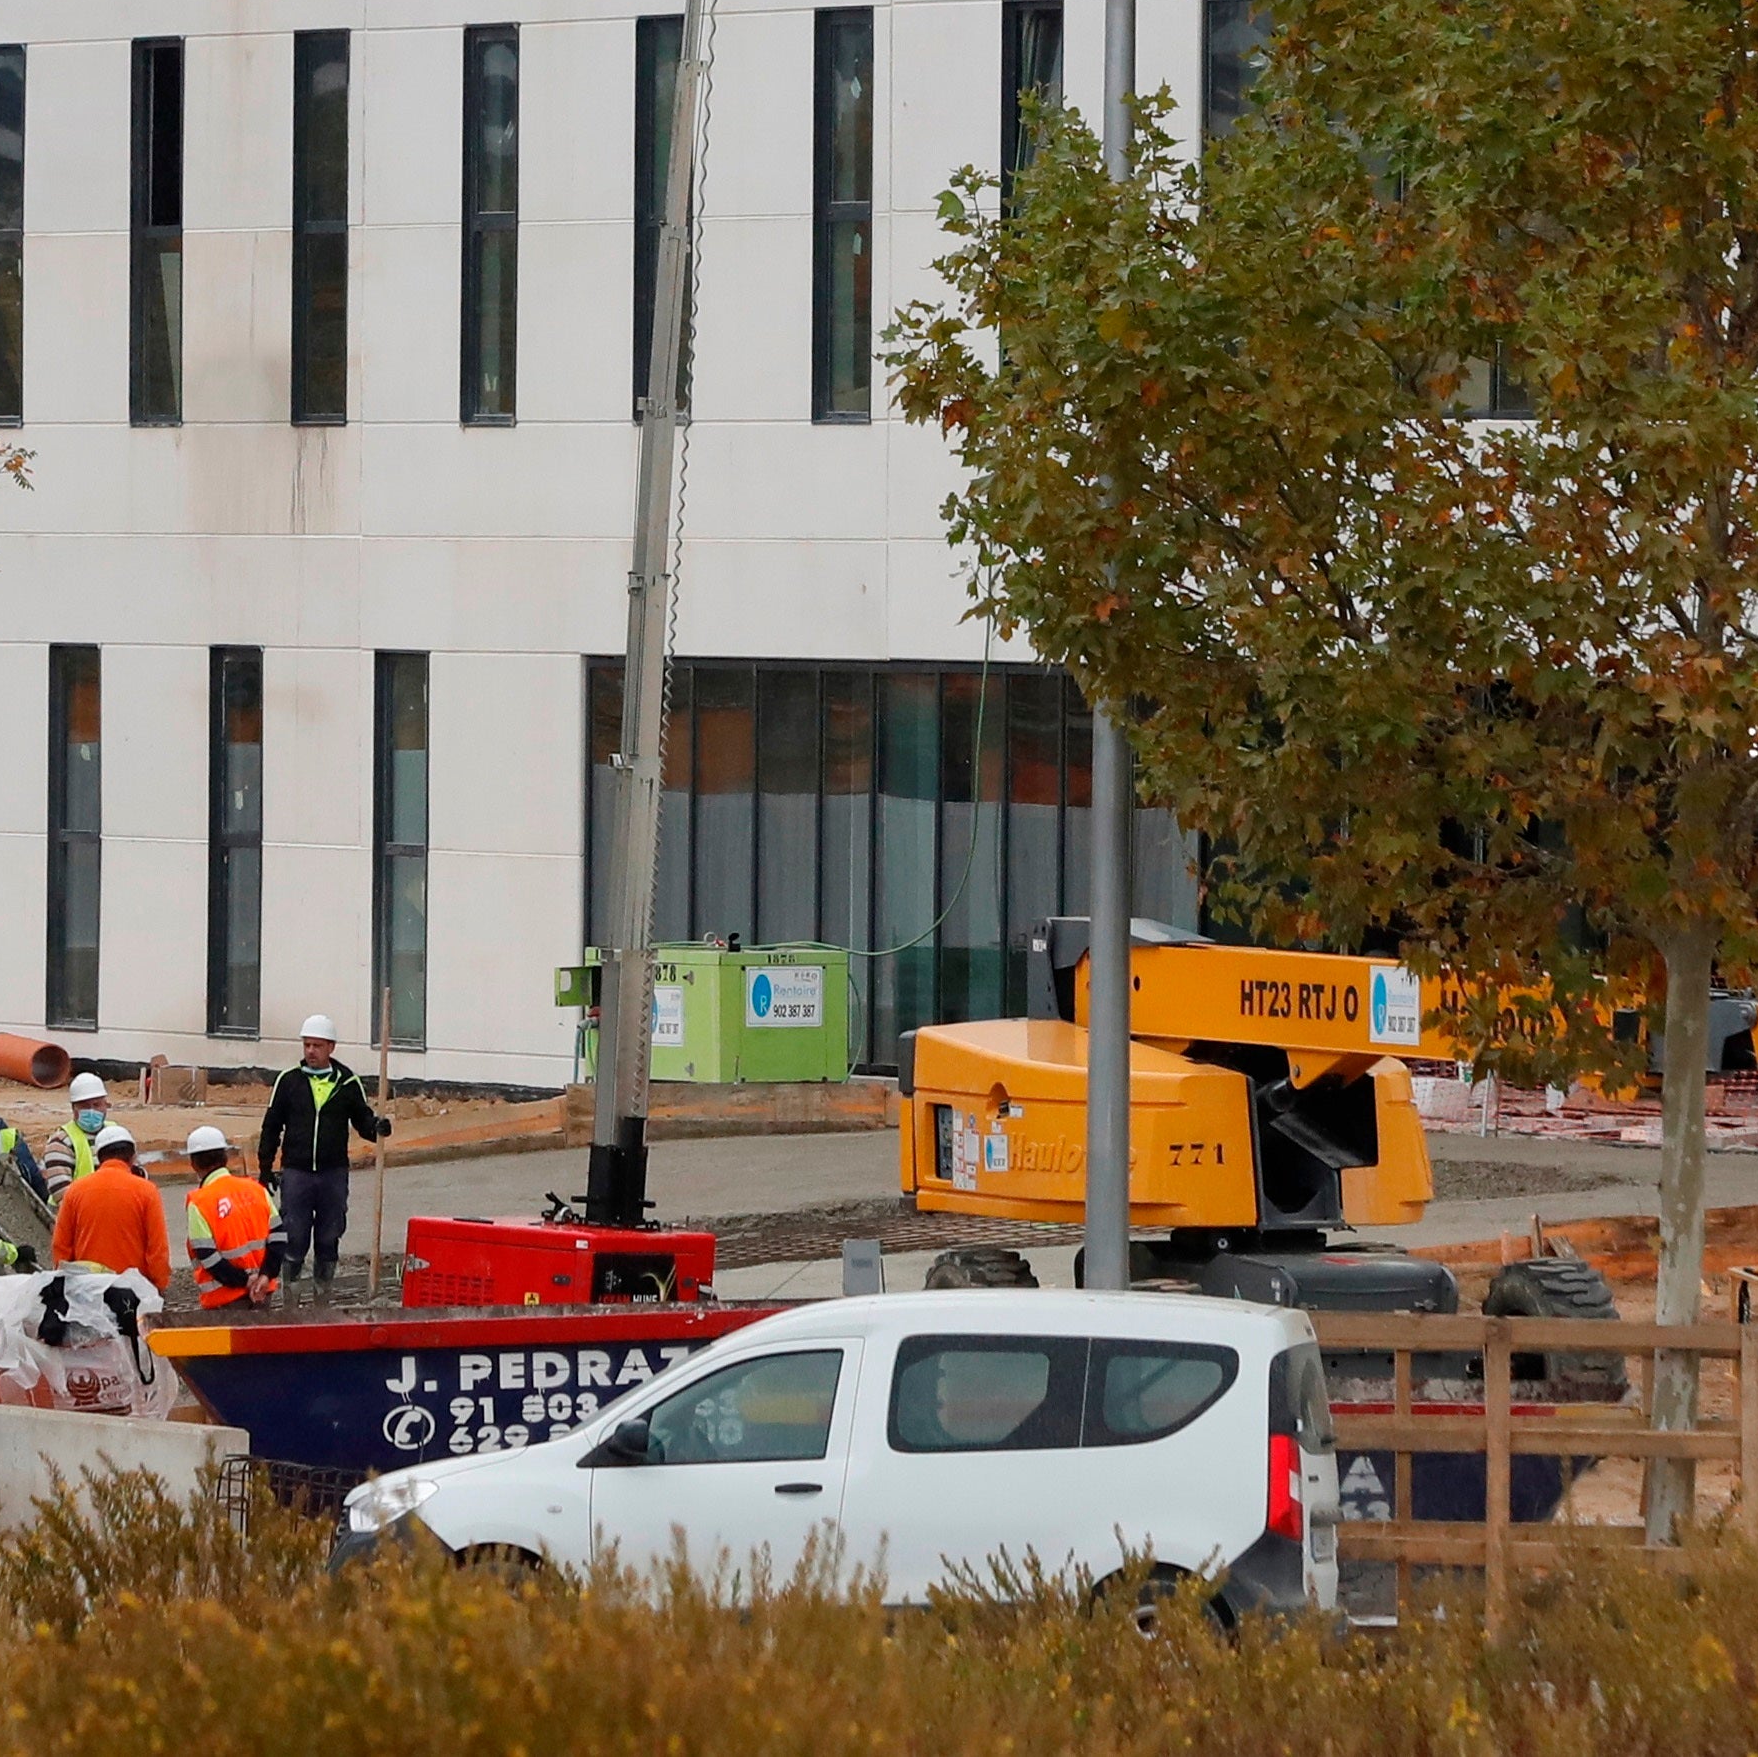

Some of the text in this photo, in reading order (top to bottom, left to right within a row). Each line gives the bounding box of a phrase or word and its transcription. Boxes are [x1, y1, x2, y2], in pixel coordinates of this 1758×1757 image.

[655, 964, 676, 982] 878
[773, 1004, 787, 1018] 902
[1240, 979, 1292, 1018] HT23
[1298, 983, 1337, 1021] RTJ
[1010, 1131, 1136, 1173] Haulo
[1168, 1143, 1225, 1167] 771
[386, 1346, 690, 1393] J. PEDRAZ
[449, 1392, 599, 1425] 91 803
[448, 1423, 529, 1454] 629
